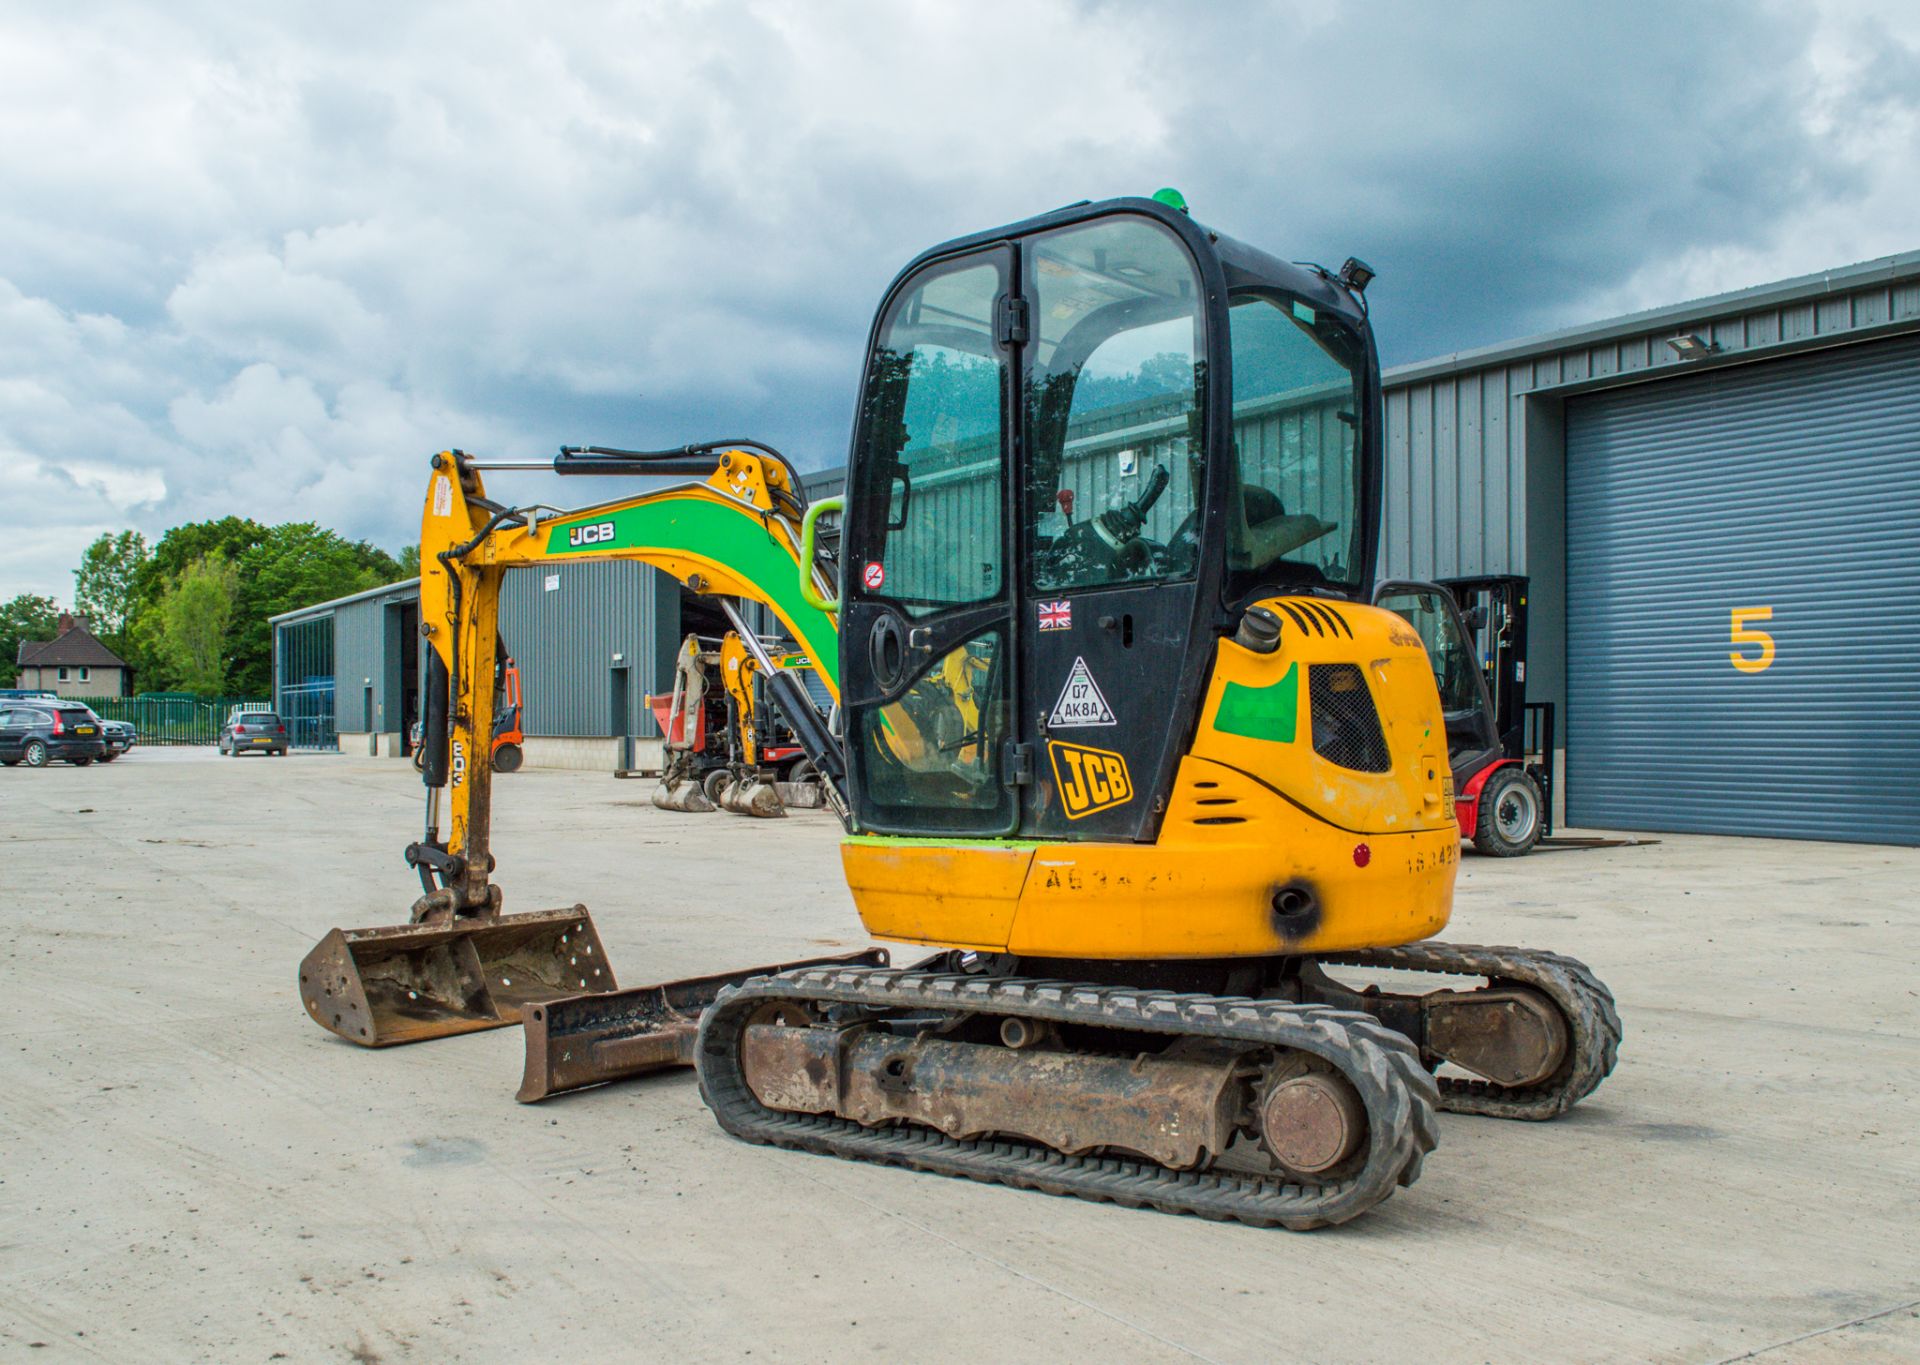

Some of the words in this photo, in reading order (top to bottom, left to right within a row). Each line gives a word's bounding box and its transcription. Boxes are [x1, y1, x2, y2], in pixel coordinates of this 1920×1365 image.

[570, 522, 615, 546] JCB
[1730, 607, 1775, 673] 5
[1073, 684, 1088, 699] 07
[1065, 702, 1098, 717] AK8A
[1063, 749, 1127, 811] JCB
